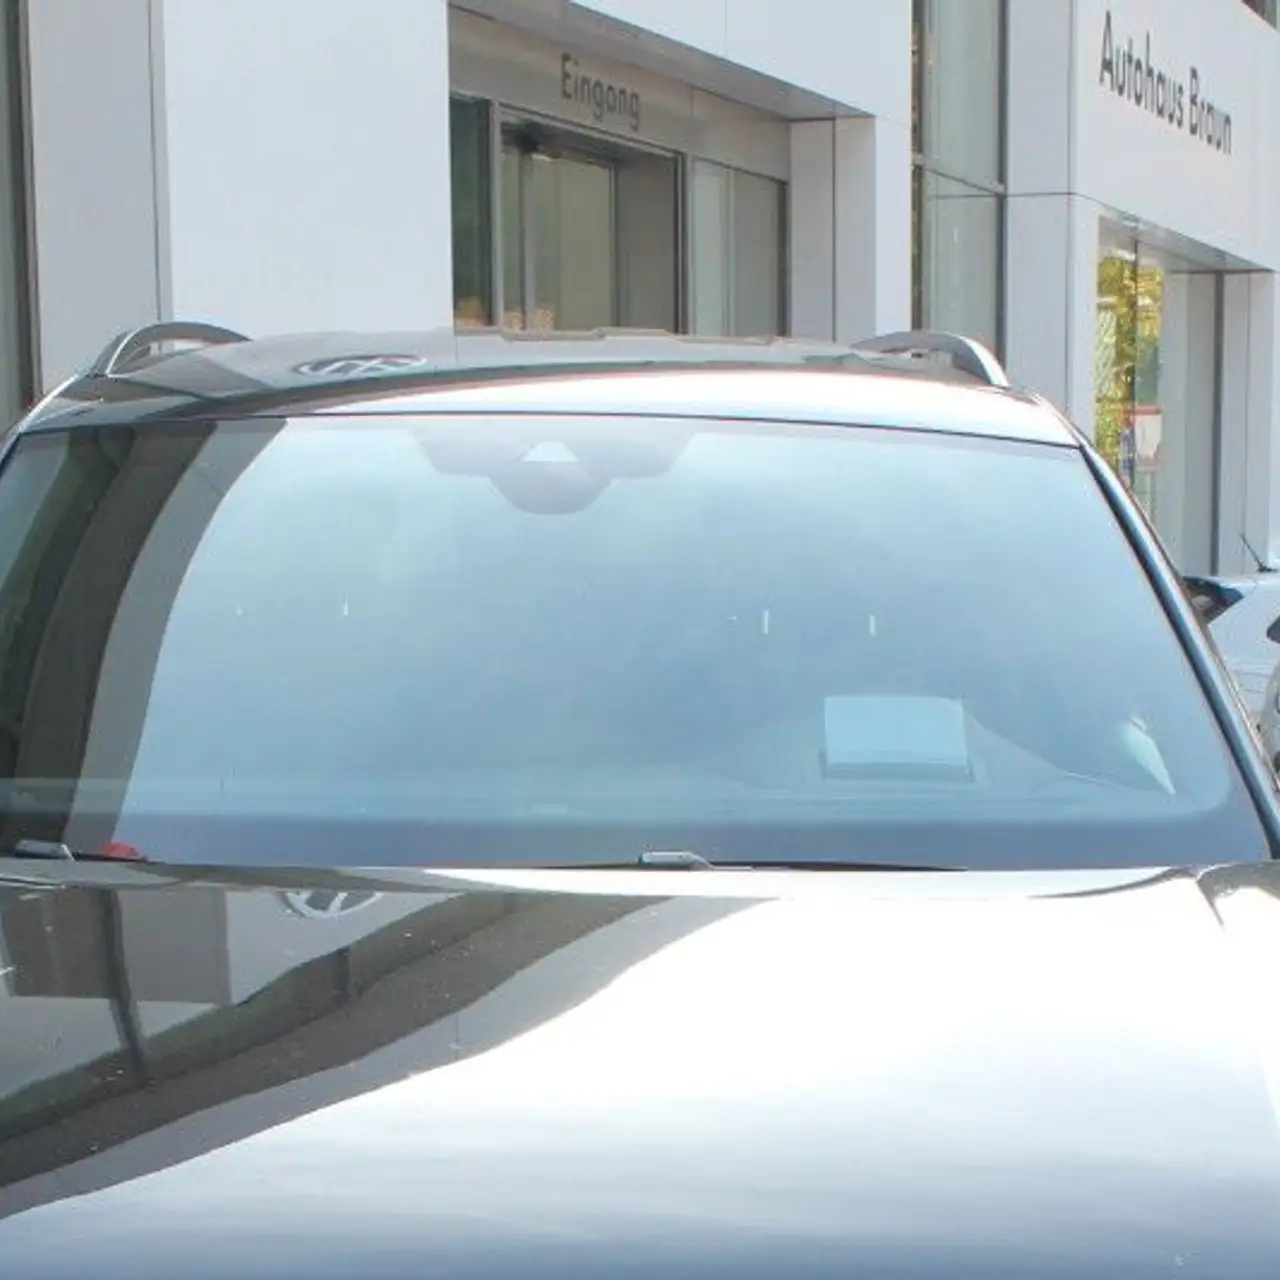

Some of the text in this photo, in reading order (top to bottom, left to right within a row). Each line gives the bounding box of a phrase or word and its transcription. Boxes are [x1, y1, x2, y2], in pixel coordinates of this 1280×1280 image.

[561, 52, 639, 132] Eingang
[1099, 10, 1232, 156] Autohaus Braun
